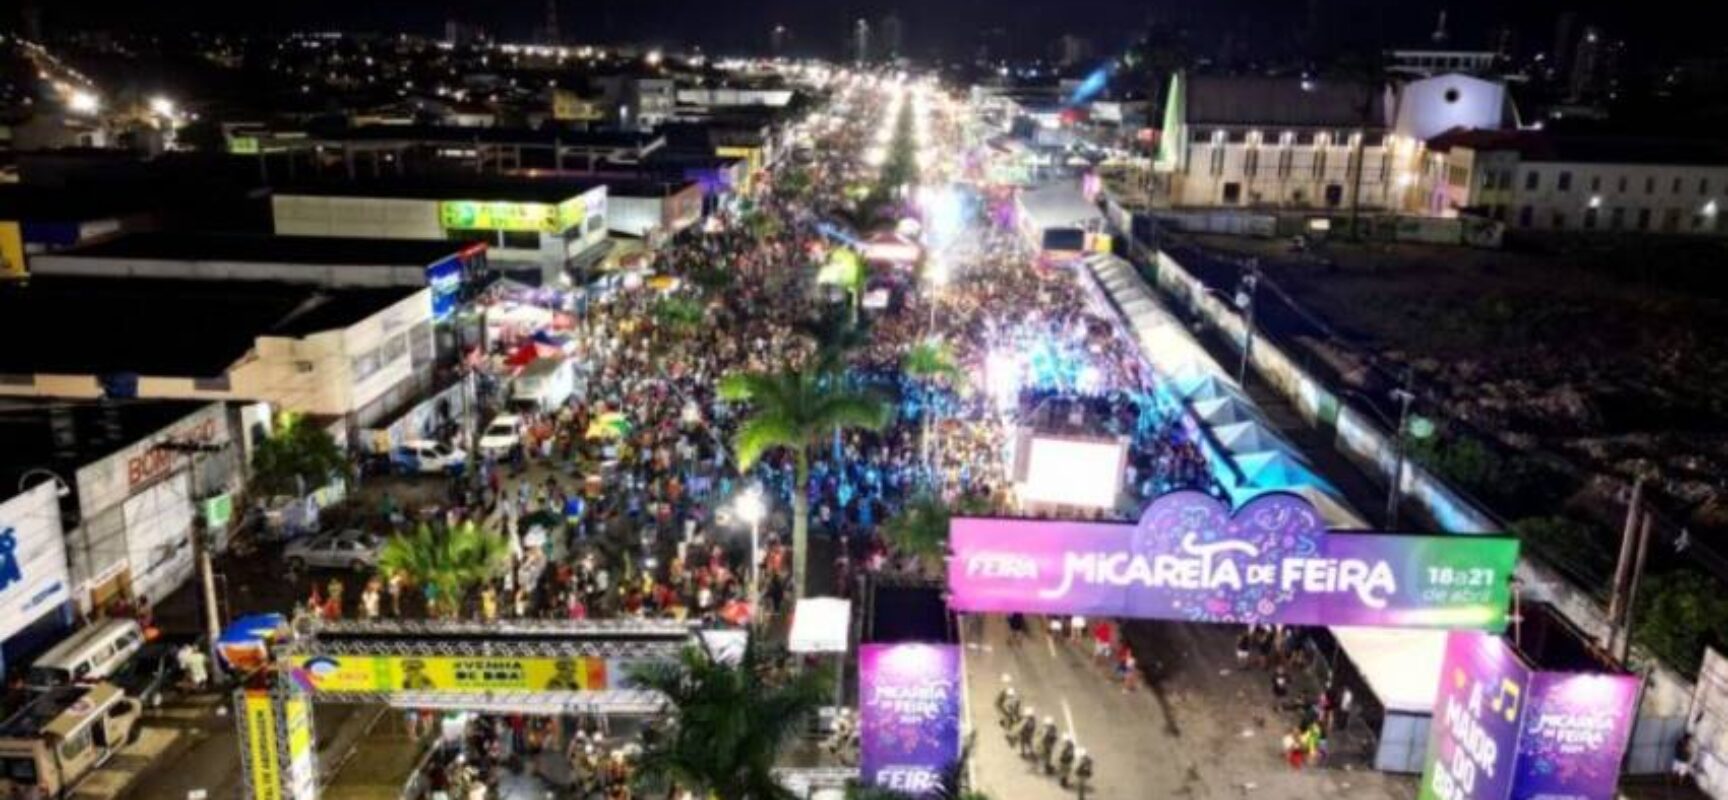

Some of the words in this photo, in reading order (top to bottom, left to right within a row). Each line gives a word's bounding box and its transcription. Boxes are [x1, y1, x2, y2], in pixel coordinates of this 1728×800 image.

[967, 552, 1038, 579] FEIRA
[1039, 531, 1258, 599] MICARETA
[1246, 563, 1276, 585] DE
[1280, 557, 1396, 609] FEIRA
[1468, 680, 1482, 720] A
[1446, 694, 1498, 779] MAIOR
[1452, 745, 1476, 794] DO
